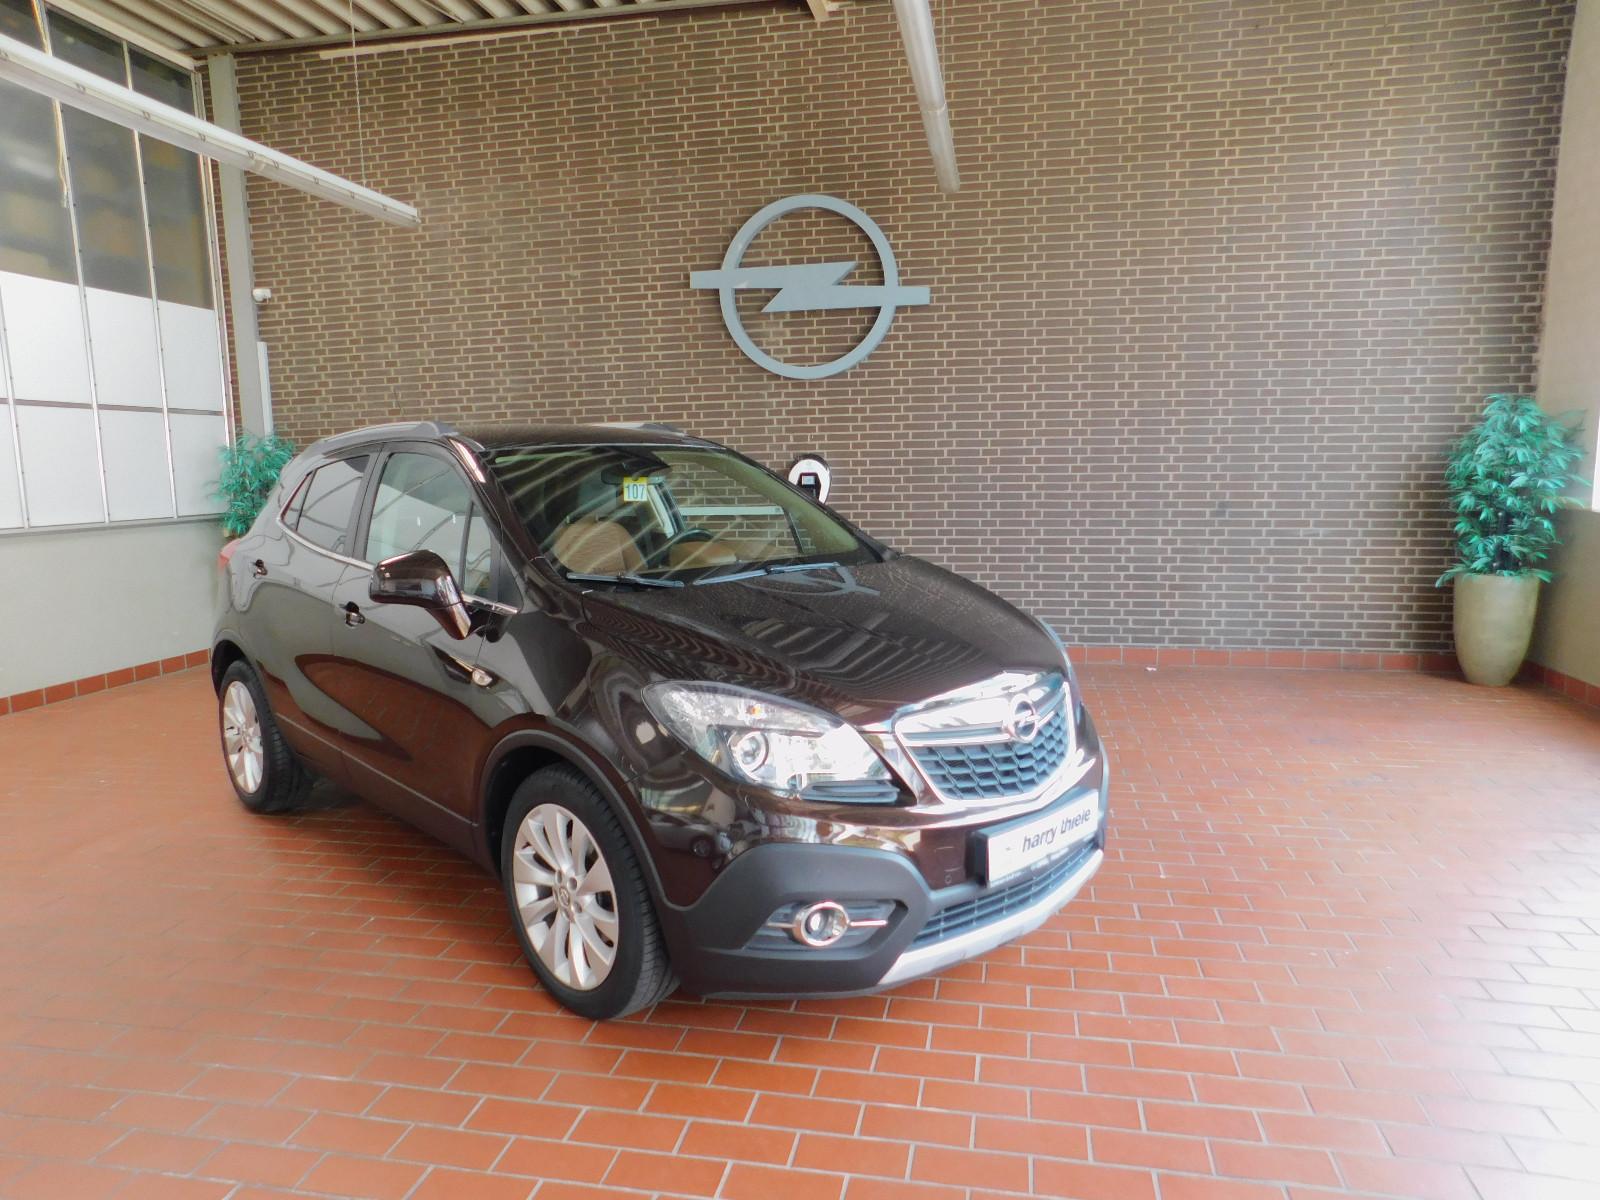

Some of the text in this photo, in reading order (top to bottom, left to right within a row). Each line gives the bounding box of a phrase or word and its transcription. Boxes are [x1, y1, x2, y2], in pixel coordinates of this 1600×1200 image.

[625, 484, 645, 499] 107
[1022, 809, 1091, 853] harry thiele
